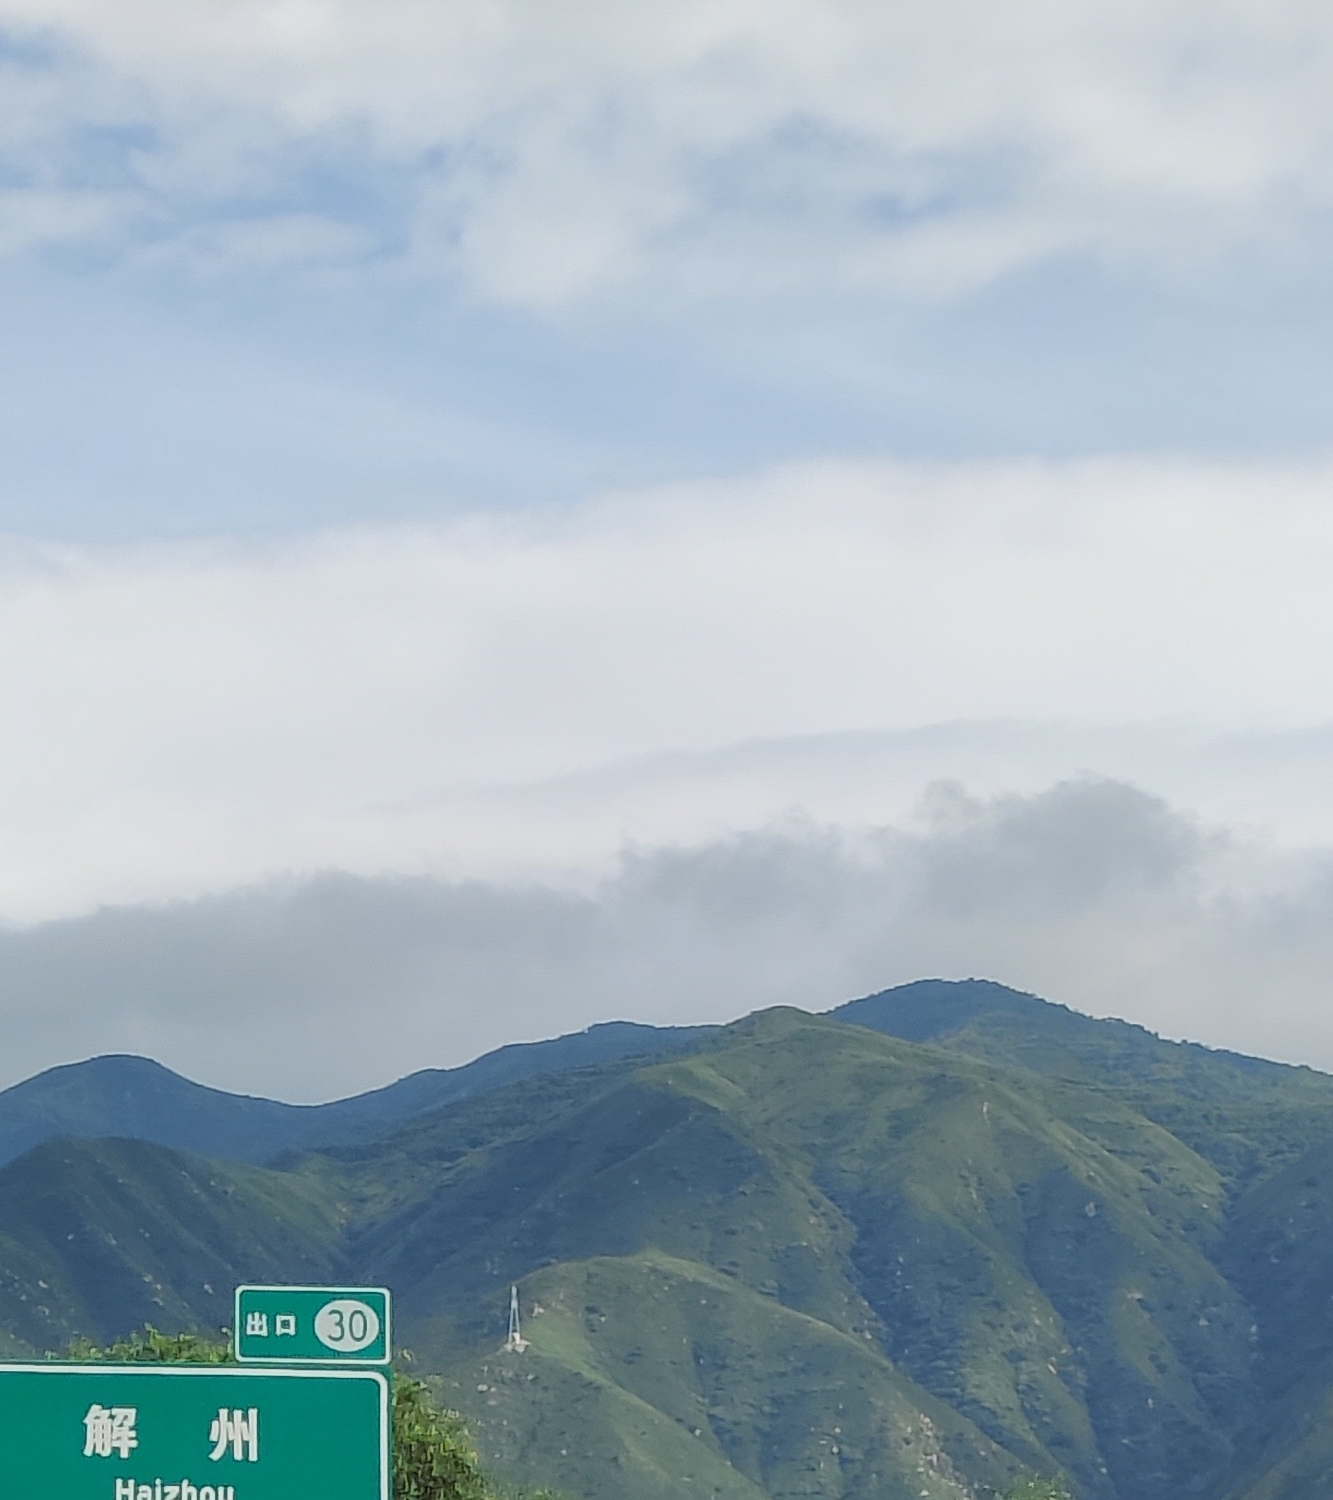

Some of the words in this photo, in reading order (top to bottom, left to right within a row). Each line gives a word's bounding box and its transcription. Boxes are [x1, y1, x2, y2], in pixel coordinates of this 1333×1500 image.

[245, 1312, 296, 1337] 出口
[327, 1310, 368, 1342] 30
[82, 1403, 260, 1462] 解州
